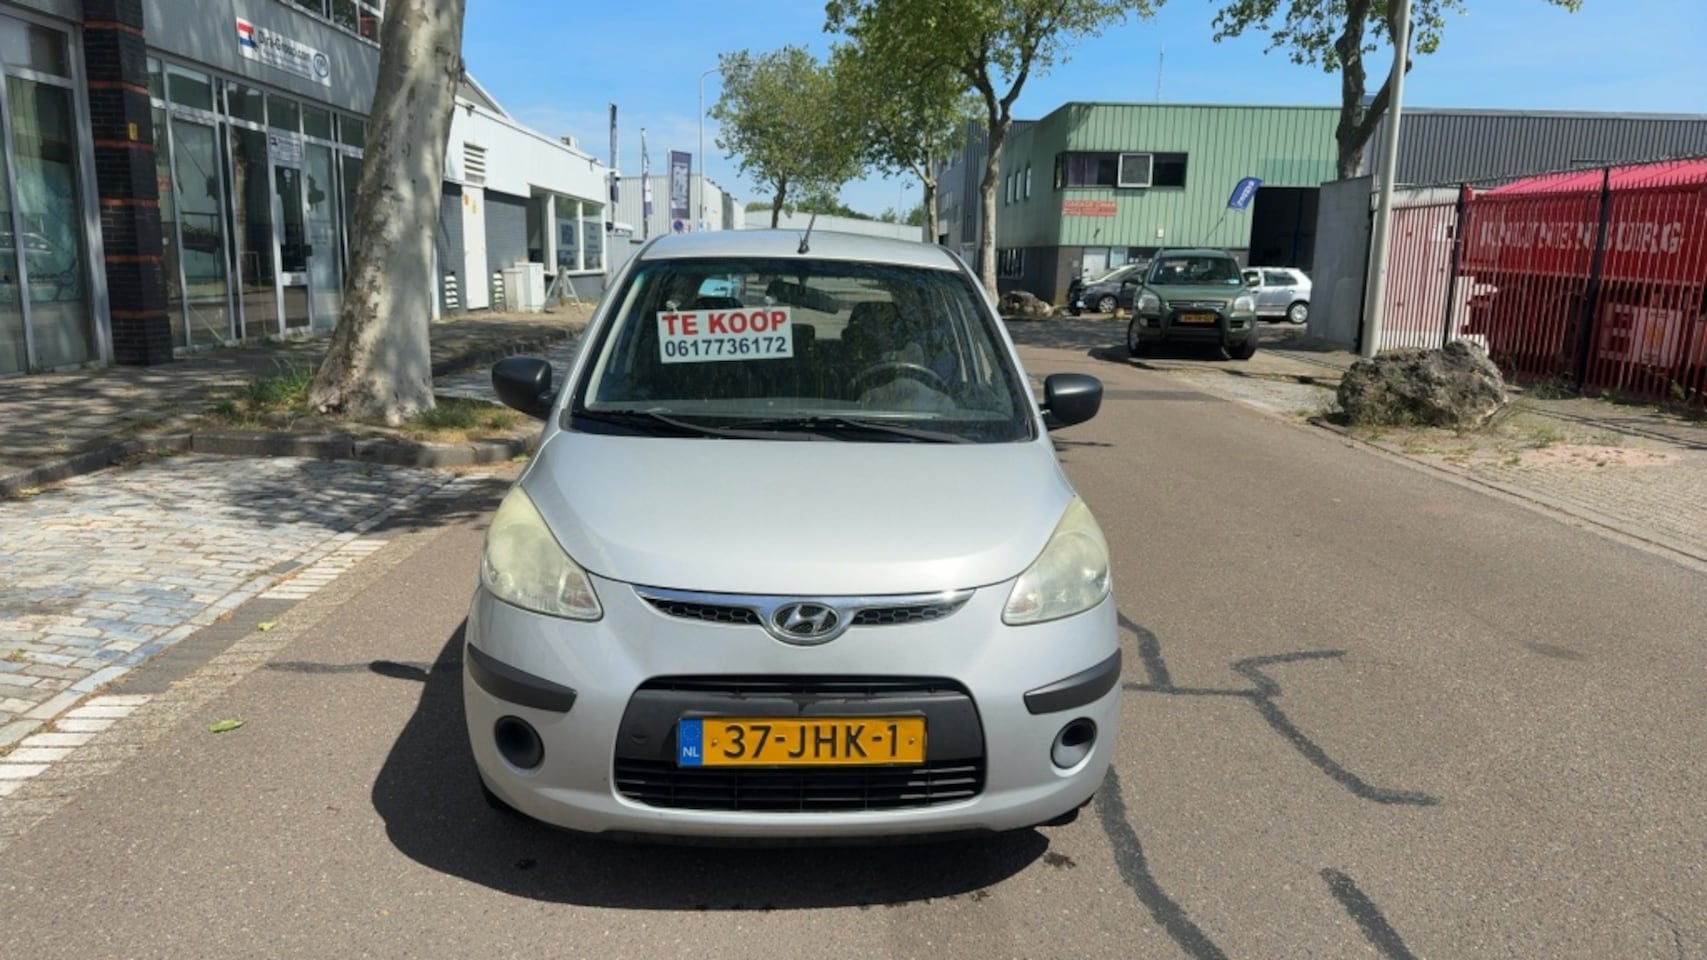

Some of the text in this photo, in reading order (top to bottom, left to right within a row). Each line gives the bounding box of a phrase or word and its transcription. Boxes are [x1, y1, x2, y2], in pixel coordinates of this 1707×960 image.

[661, 311, 788, 336] TE KOOP
[665, 336, 787, 357] 0617736172
[682, 747, 700, 758] NL
[723, 724, 898, 759] 37-JHK-1
